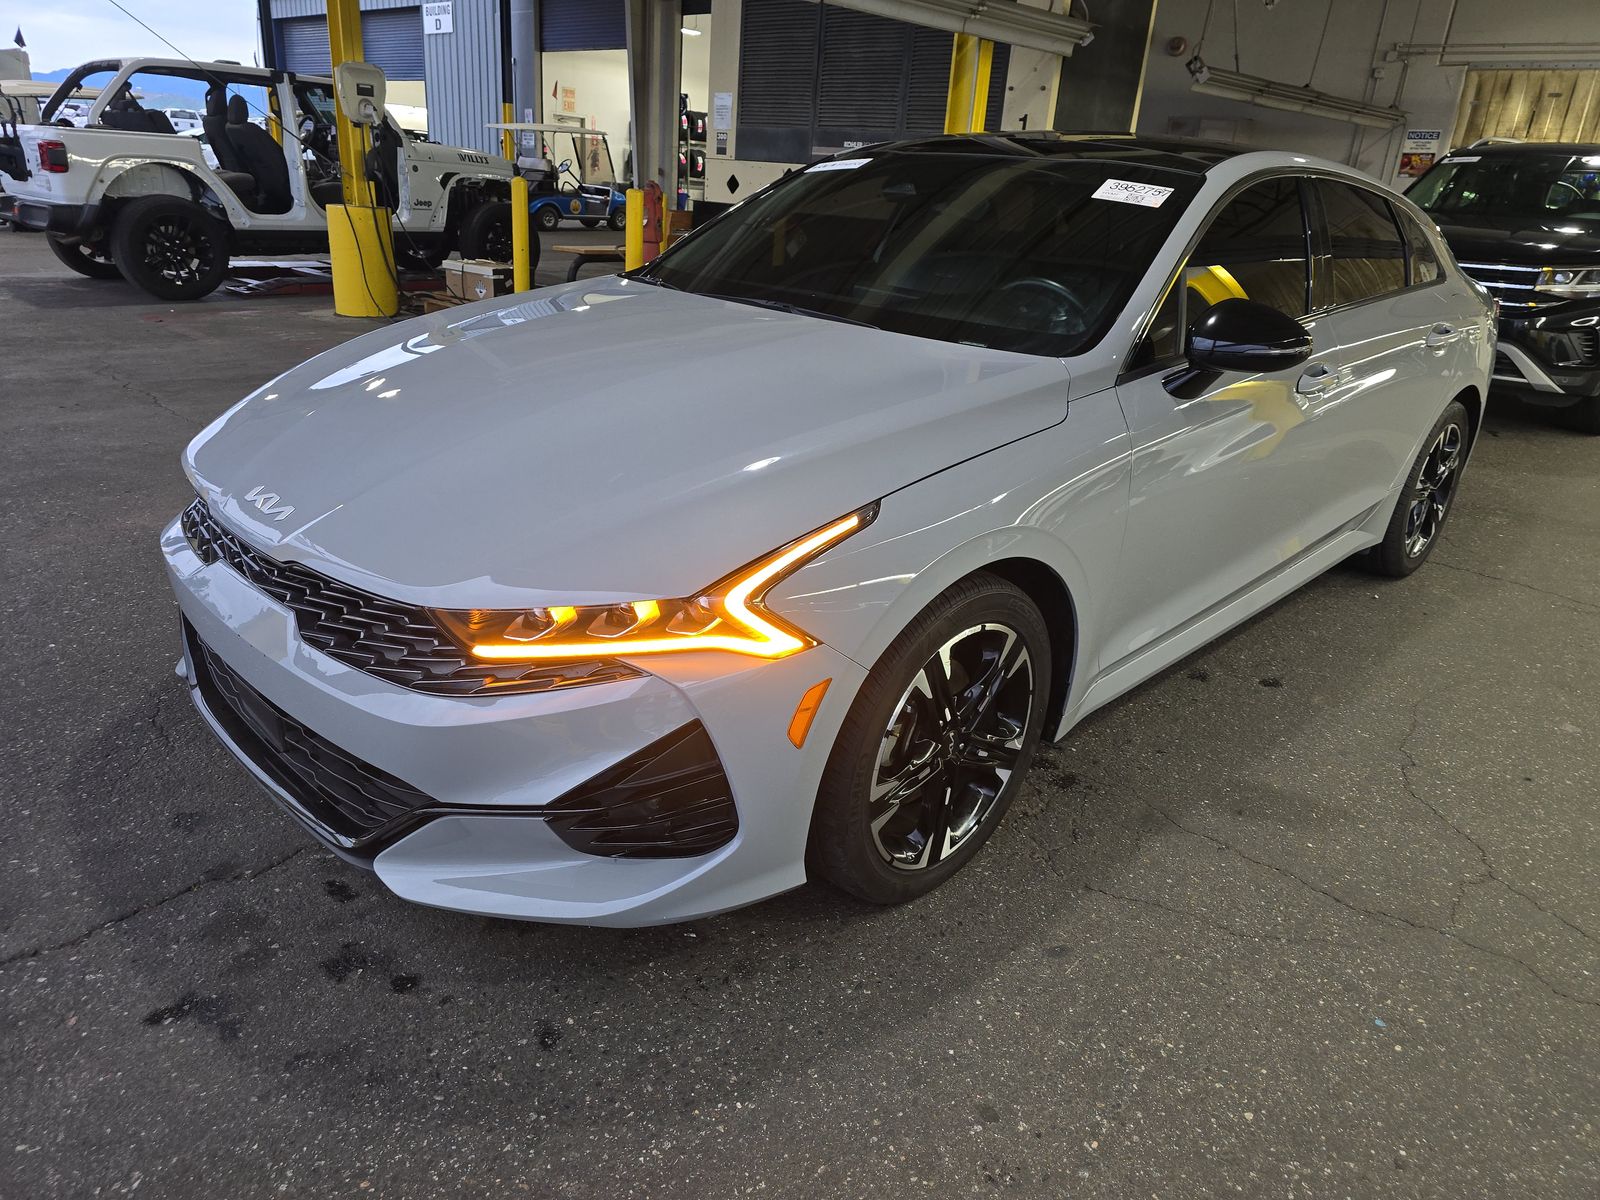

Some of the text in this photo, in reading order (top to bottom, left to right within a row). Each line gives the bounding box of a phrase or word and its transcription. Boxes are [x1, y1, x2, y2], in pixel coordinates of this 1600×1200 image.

[425, 4, 451, 17] BUILDING
[435, 18, 442, 31] D
[1018, 113, 1028, 131] 1
[1407, 132, 1439, 140] NOTICE
[413, 198, 433, 208] Jeep
[243, 485, 297, 521] KIA
